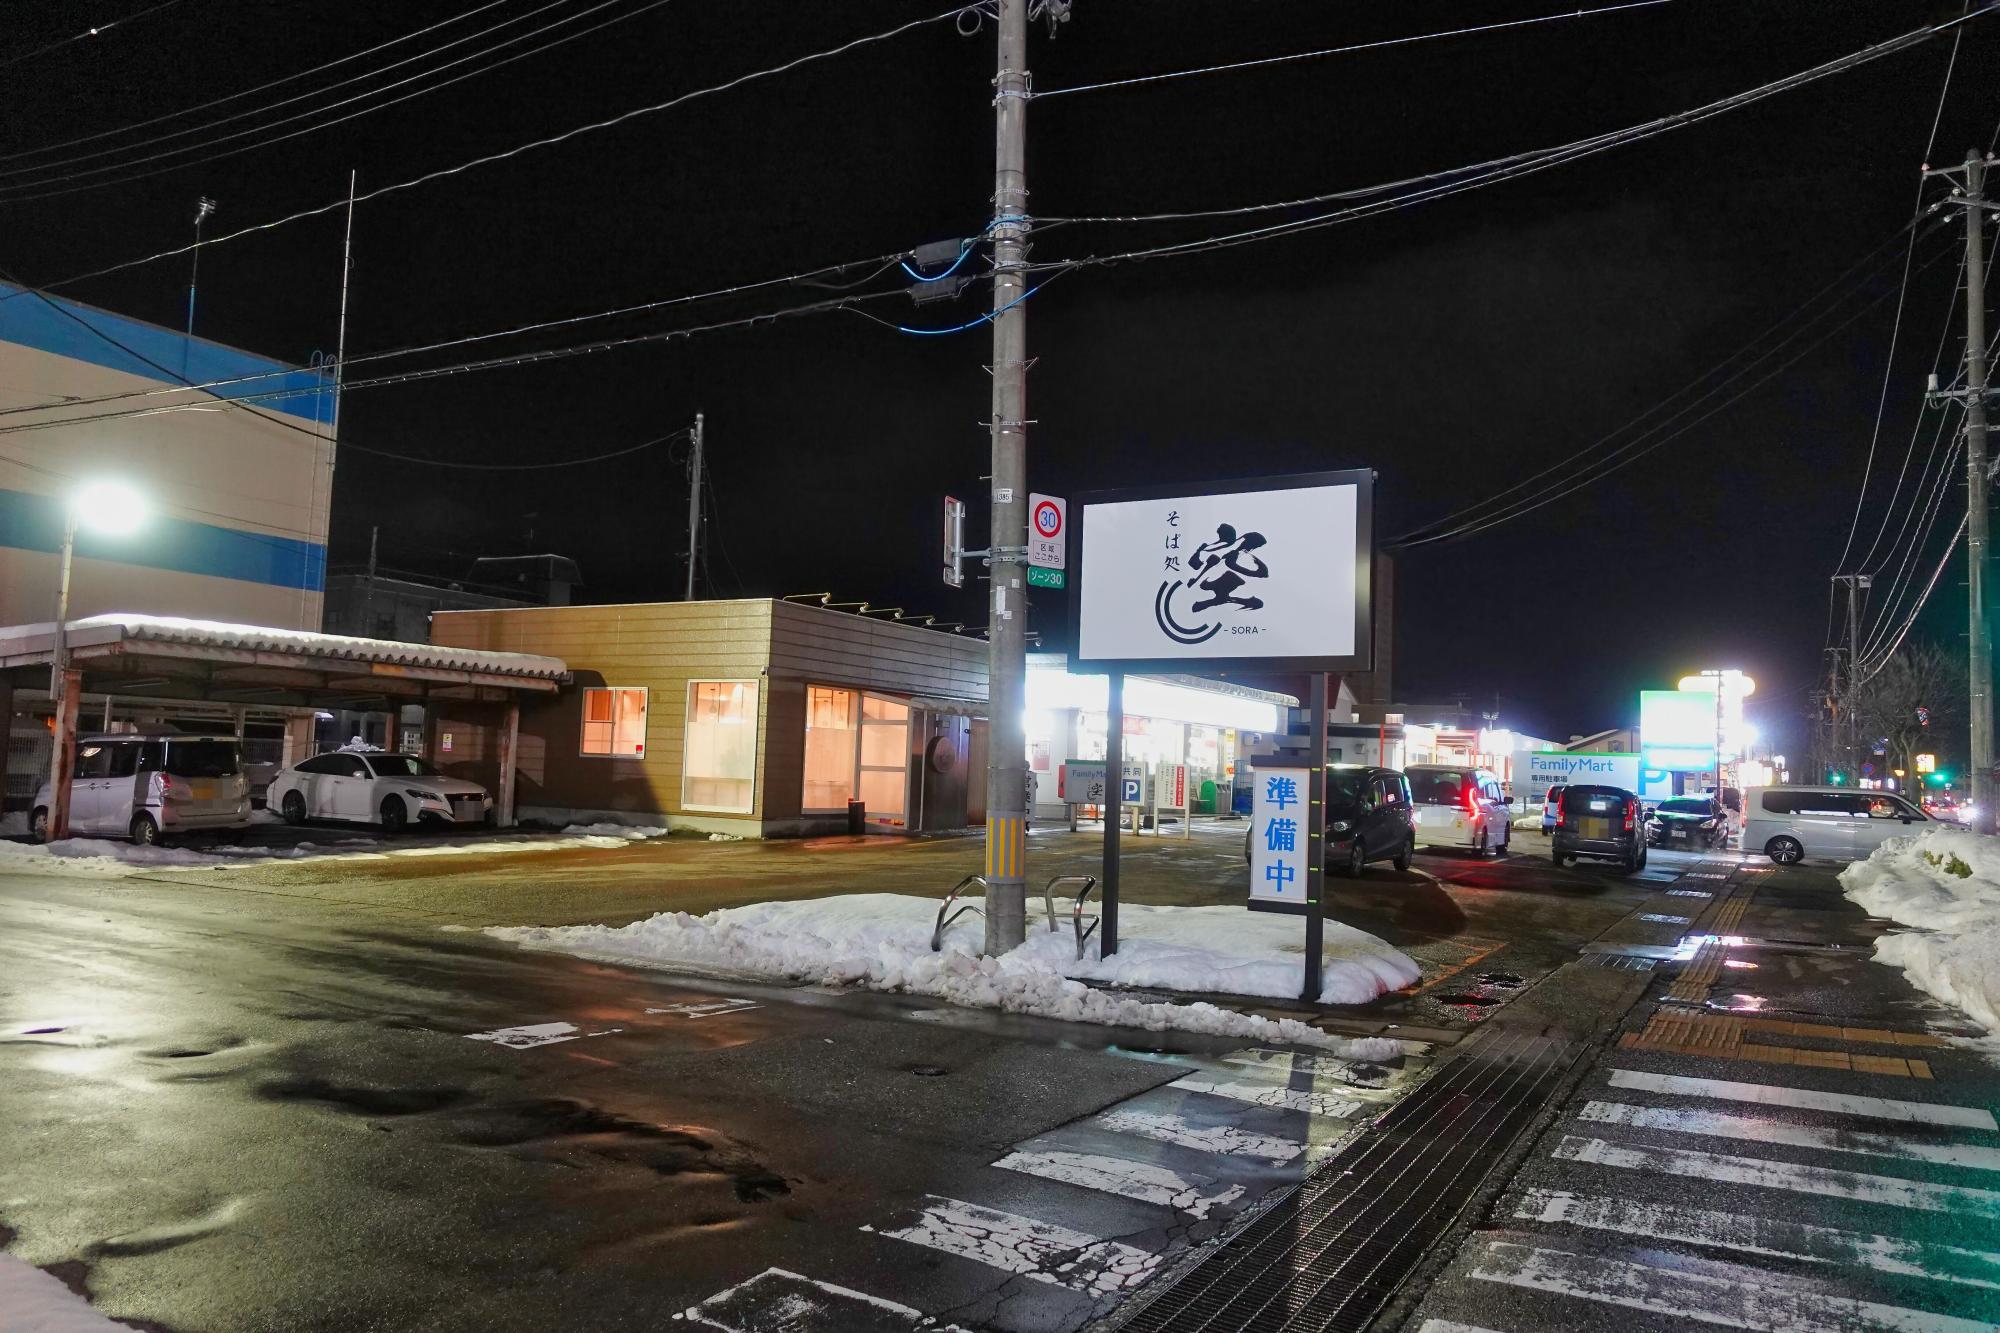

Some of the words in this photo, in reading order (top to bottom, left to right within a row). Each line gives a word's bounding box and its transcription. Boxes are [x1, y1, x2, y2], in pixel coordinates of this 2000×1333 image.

[1040, 510, 1056, 528] 30
[1041, 543, 1055, 553] 区域
[1163, 510, 1182, 573] そば処
[1034, 552, 1060, 563] ここから
[1187, 523, 1269, 613] 空
[1231, 626, 1259, 635] SORA
[1072, 769, 1106, 780] FamilyM
[1123, 767, 1142, 777] 共同
[1531, 757, 1614, 775] FamilyMart
[1125, 781, 1139, 800] P
[1264, 776, 1298, 893] 準備中
